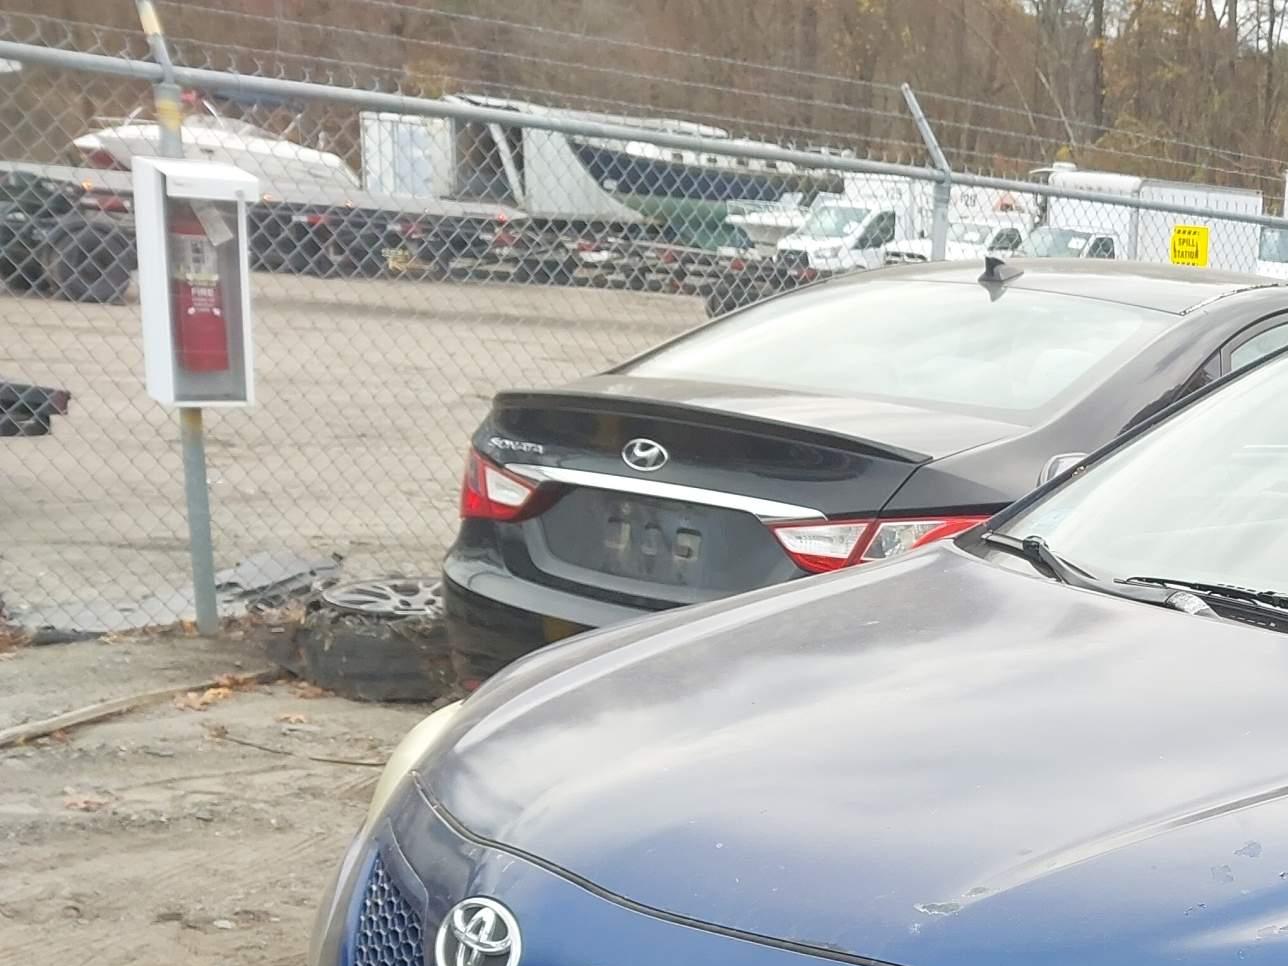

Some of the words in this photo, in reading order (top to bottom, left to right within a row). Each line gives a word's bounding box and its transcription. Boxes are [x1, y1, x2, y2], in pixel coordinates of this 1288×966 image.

[1177, 238, 1196, 247] SPILL
[191, 287, 215, 297] FIRE
[488, 436, 544, 455] SONATA
